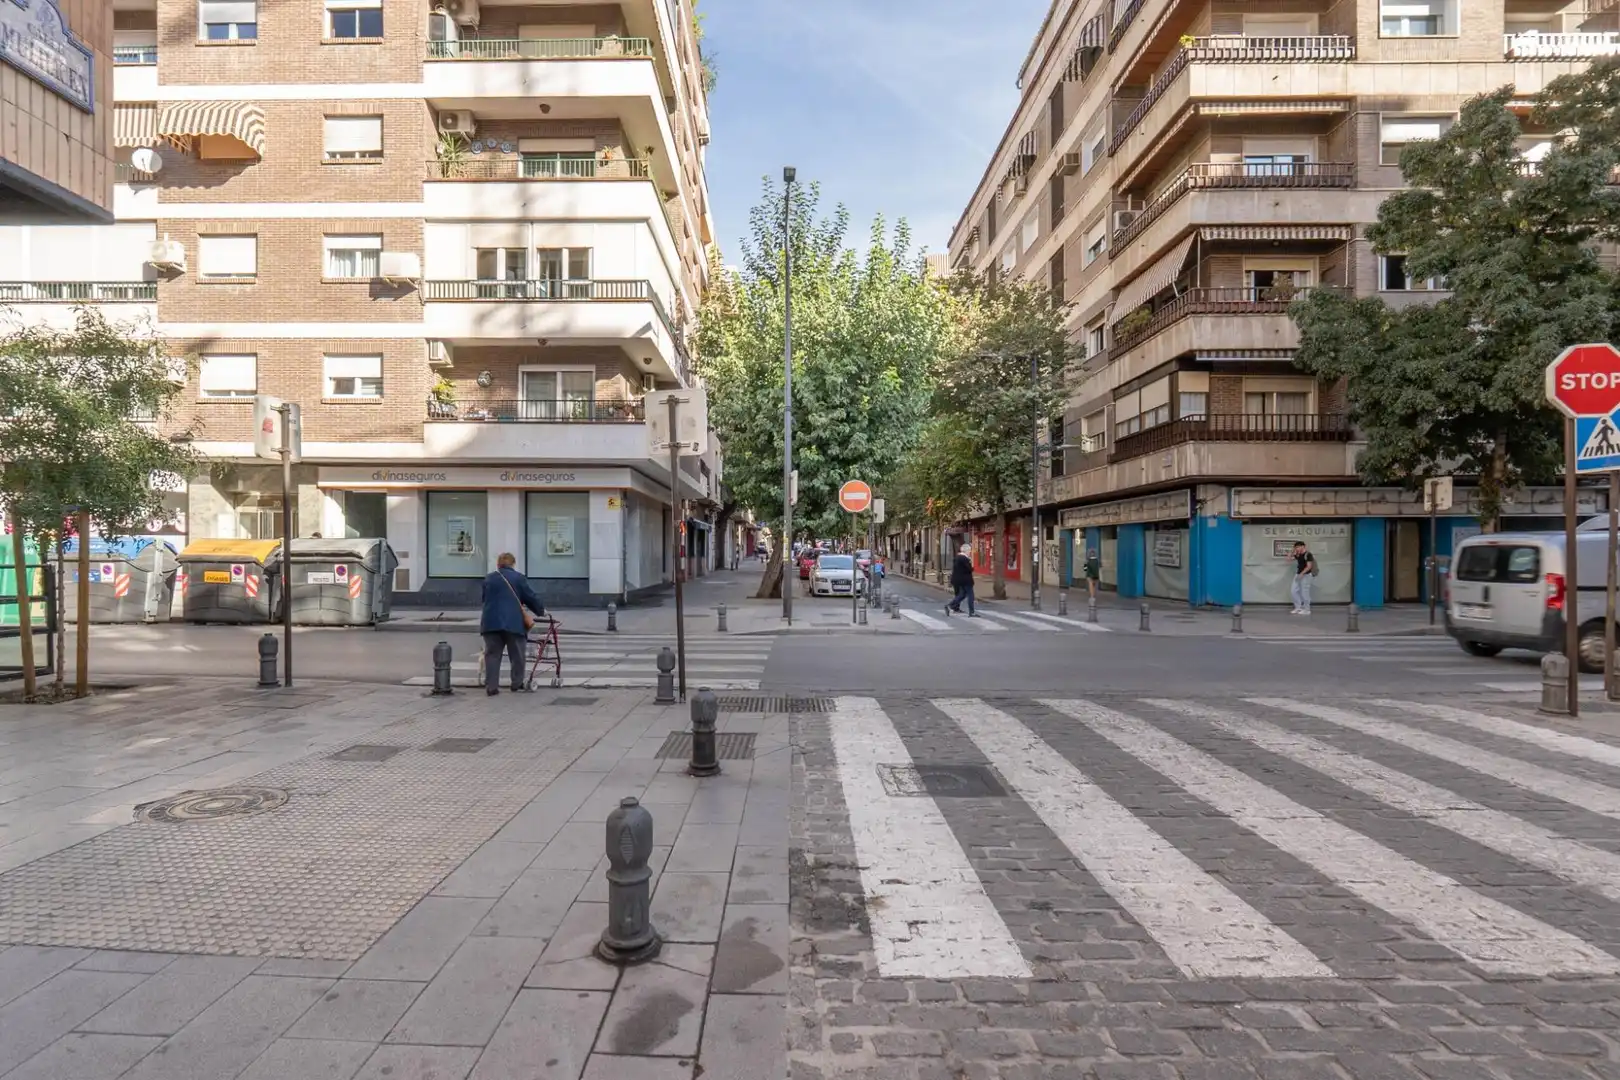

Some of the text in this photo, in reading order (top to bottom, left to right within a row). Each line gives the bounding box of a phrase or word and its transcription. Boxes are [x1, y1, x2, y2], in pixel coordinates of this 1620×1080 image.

[1560, 372, 1620, 390] STOP
[371, 469, 447, 482] divinaseguros
[500, 469, 576, 483] divinaseguros
[1264, 527, 1346, 536] SE ALQUILA
